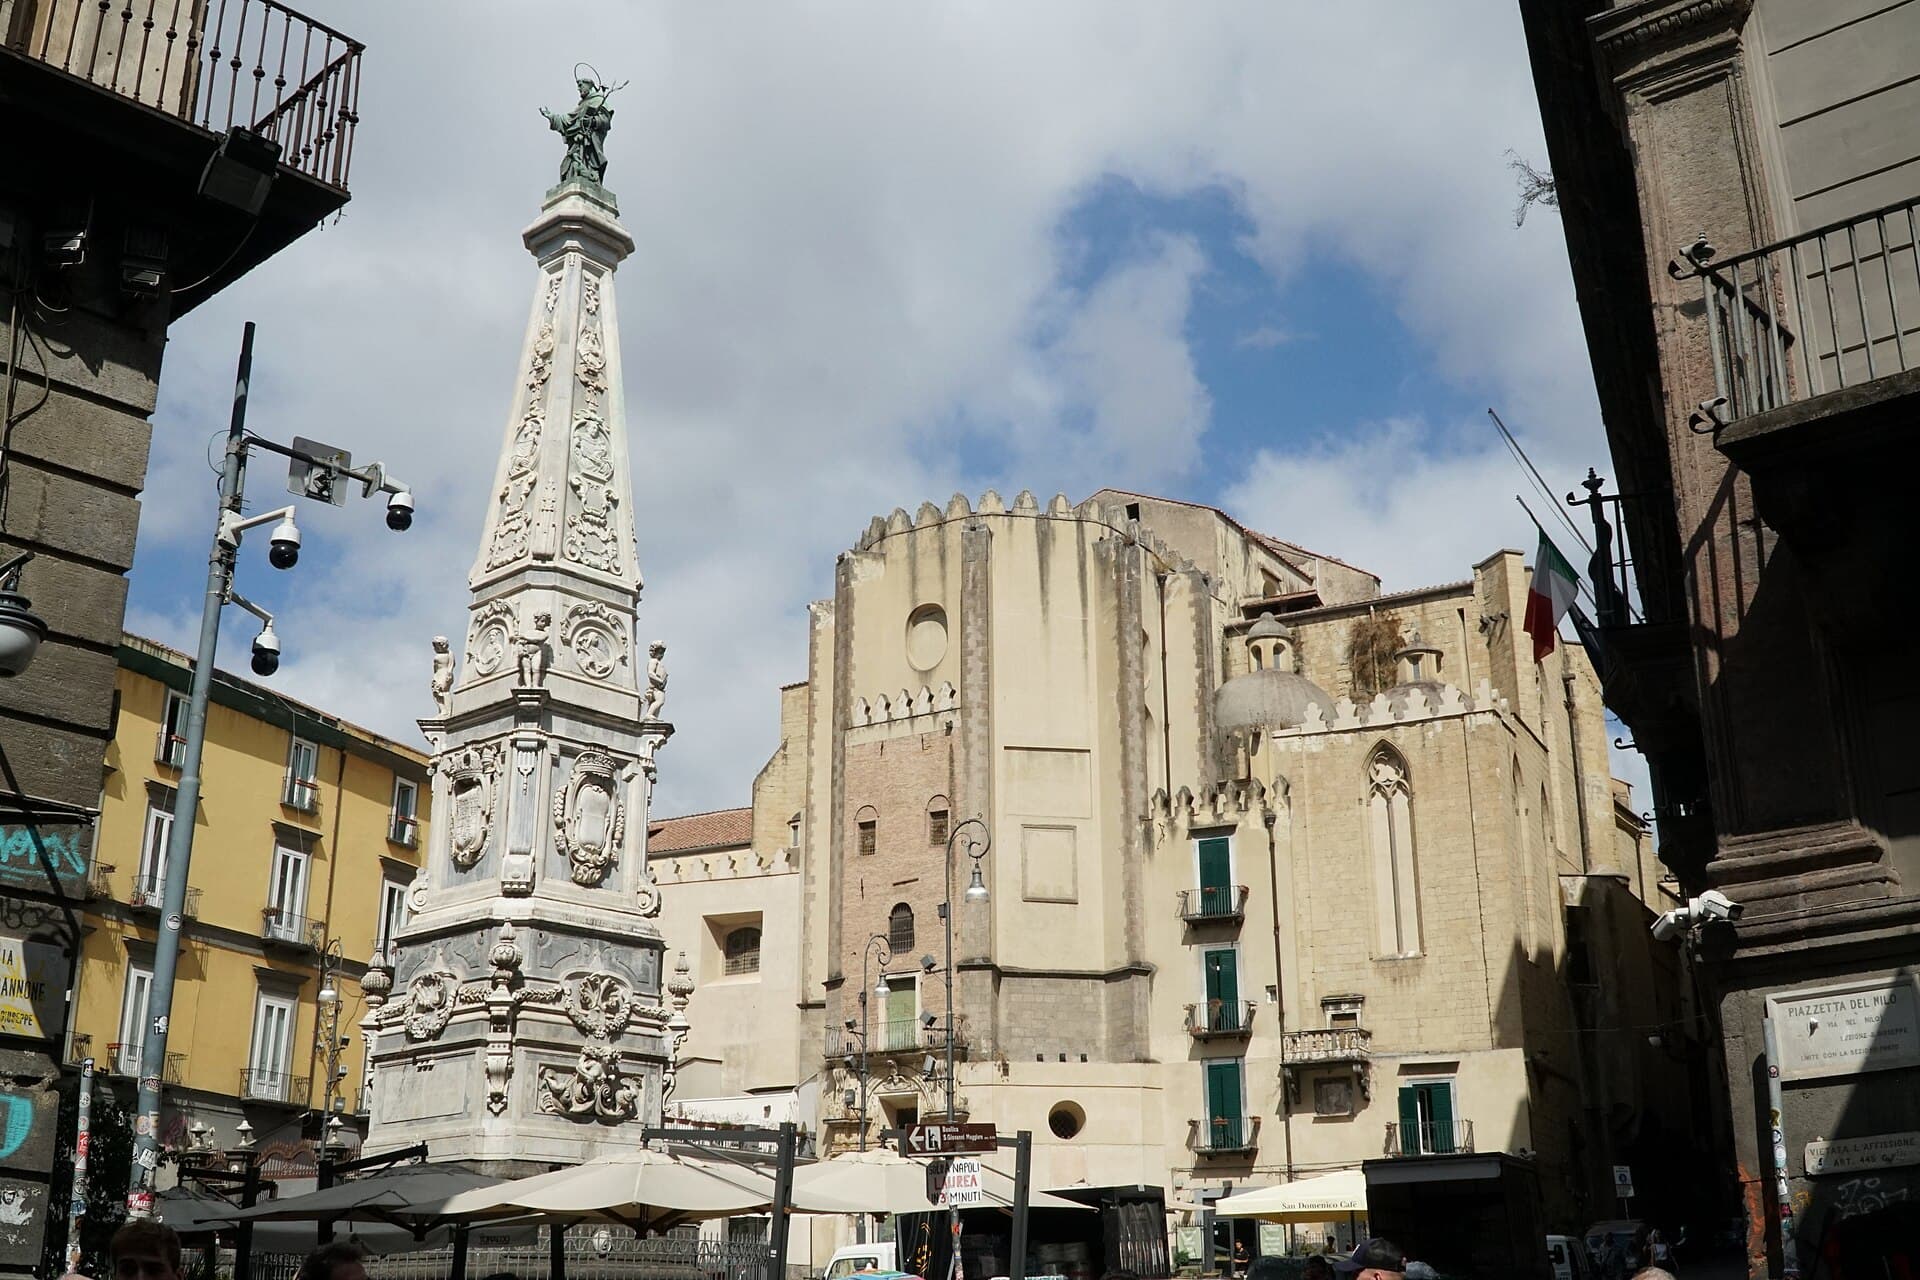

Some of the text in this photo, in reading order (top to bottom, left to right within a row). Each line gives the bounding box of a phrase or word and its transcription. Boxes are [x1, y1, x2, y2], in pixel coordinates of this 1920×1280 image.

[1788, 994, 1897, 1017] PIAZZETTA DEL NILO
[1809, 1145, 1849, 1156] VIETATA
[952, 1161, 980, 1173] NAPOLI
[934, 1174, 977, 1190] LAUREA
[950, 1191, 981, 1202] MINUTI
